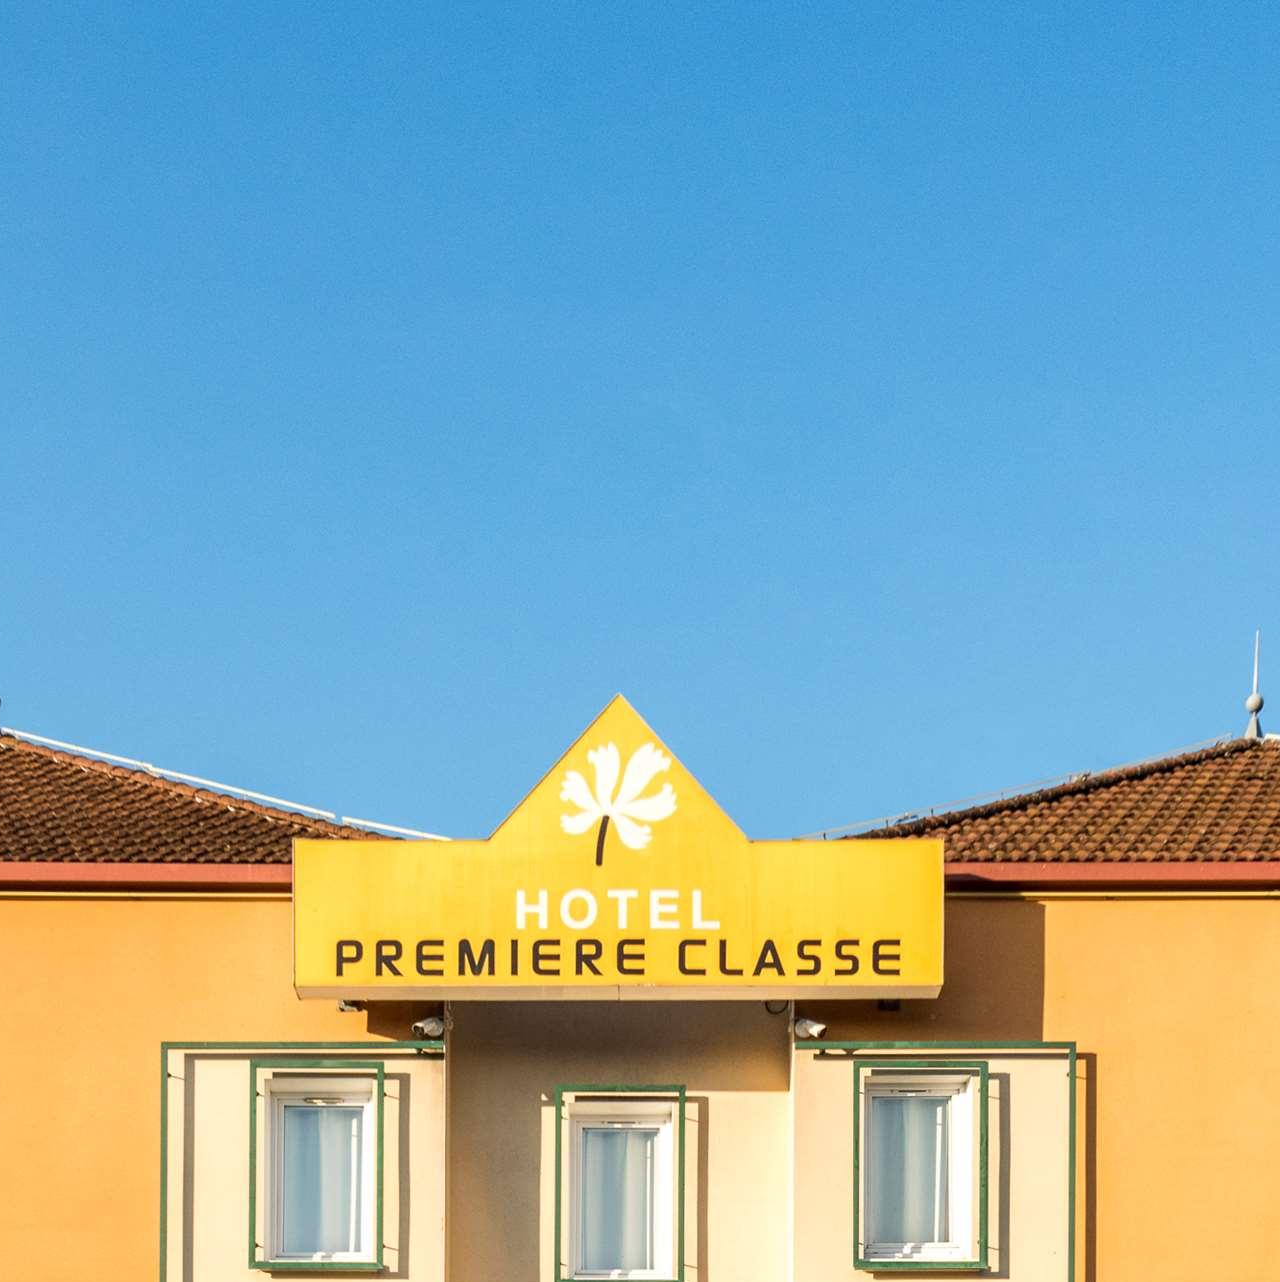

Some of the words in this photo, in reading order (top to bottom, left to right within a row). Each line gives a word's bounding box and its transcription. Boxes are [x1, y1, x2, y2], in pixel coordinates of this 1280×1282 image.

[515, 889, 721, 930] HOTEL
[335, 938, 646, 977] PREMIERE
[678, 938, 901, 977] CLASSE
